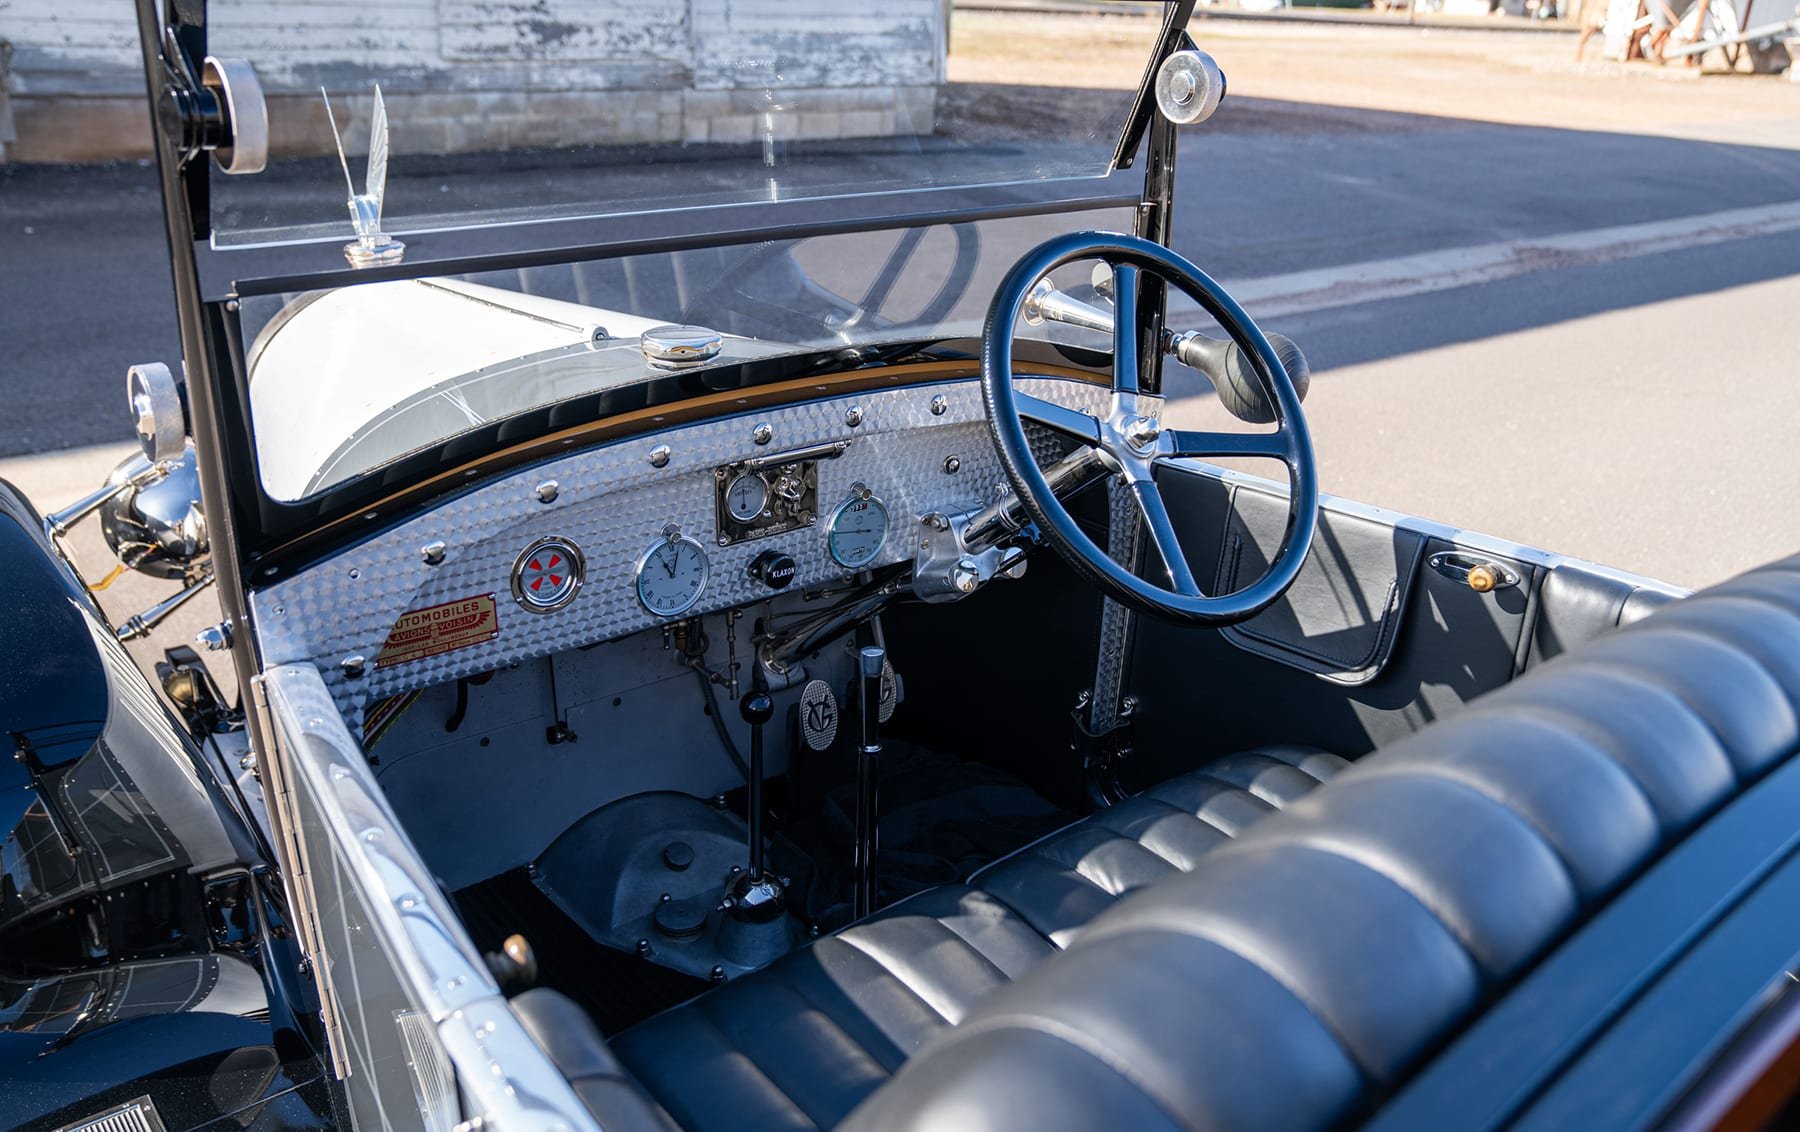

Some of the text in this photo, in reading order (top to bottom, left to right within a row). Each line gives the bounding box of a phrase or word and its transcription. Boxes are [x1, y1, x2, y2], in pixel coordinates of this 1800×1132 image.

[772, 566, 795, 579] KLAXON
[393, 602, 479, 630] UTOMOBILES
[394, 615, 475, 640] AVIONS VOISIN
